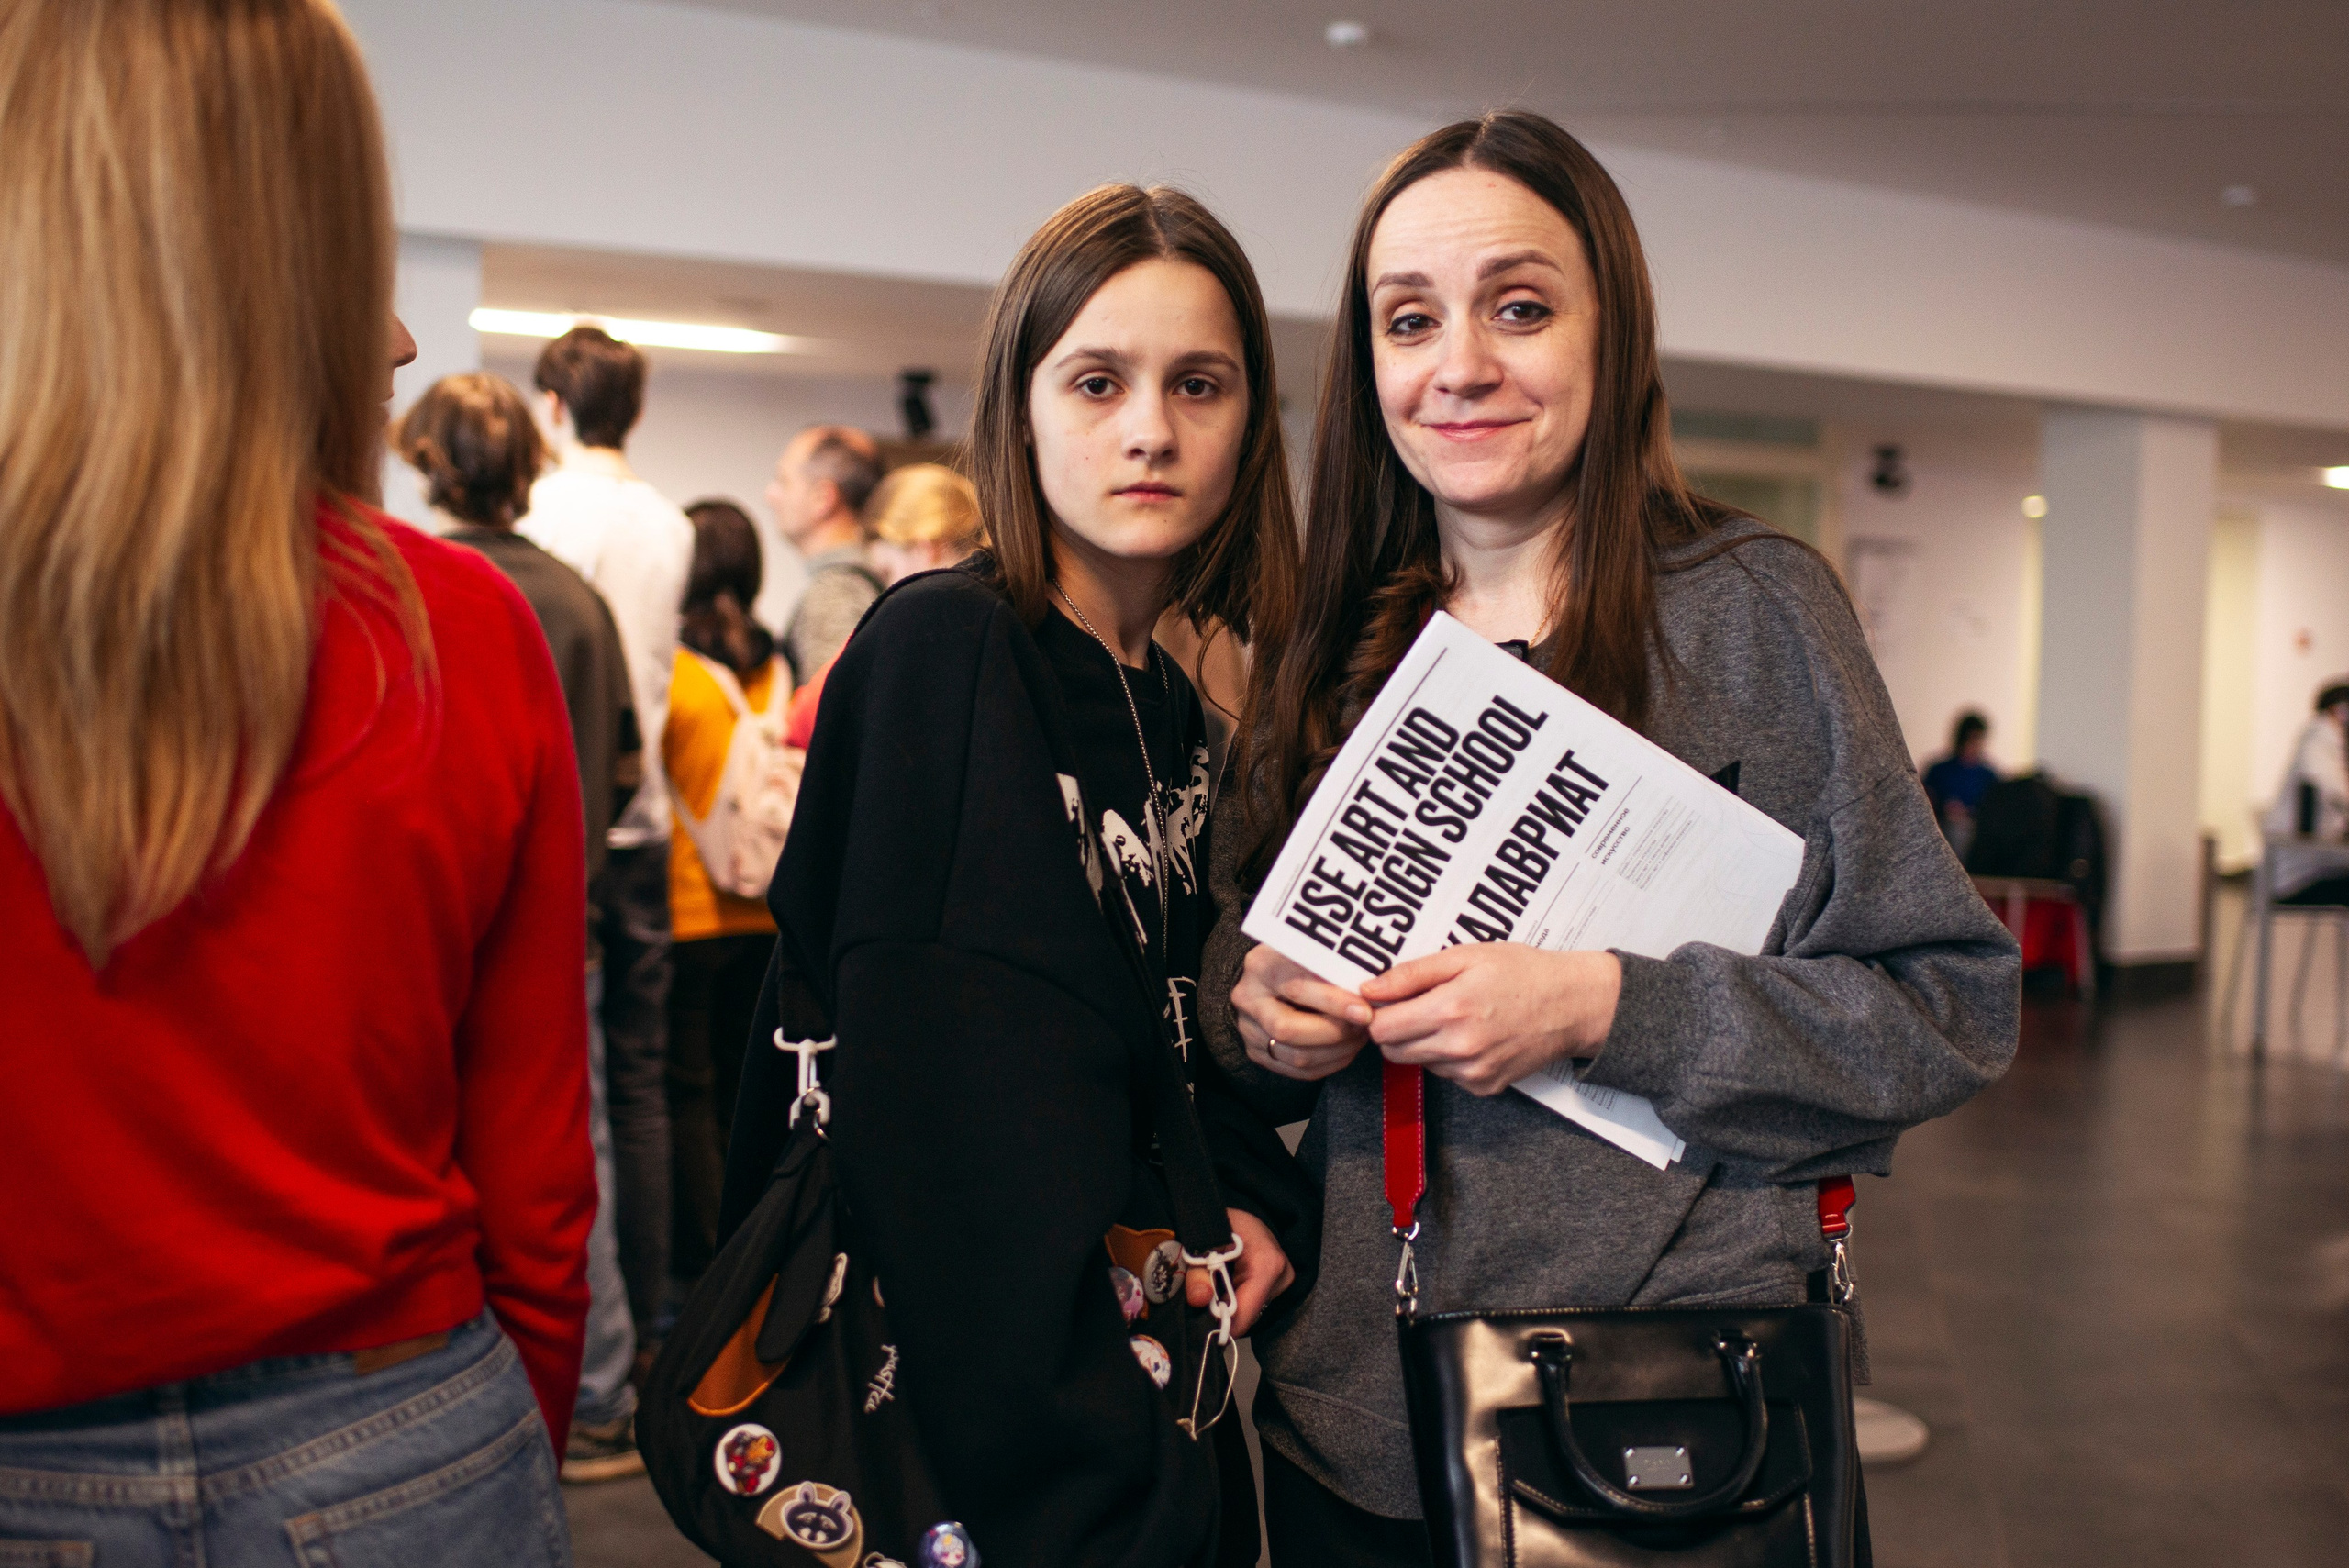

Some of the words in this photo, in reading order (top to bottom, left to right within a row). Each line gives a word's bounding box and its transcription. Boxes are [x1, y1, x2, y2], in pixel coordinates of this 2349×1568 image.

[1285, 856, 1367, 951] HSE
[1330, 778, 1408, 874] ART
[1375, 706, 1460, 800] AND
[1337, 828, 1452, 976] DESIGN
[1415, 695, 1549, 843] SCHOOL
[1591, 808, 1630, 859] современное
[1601, 827, 1630, 865] искусство
